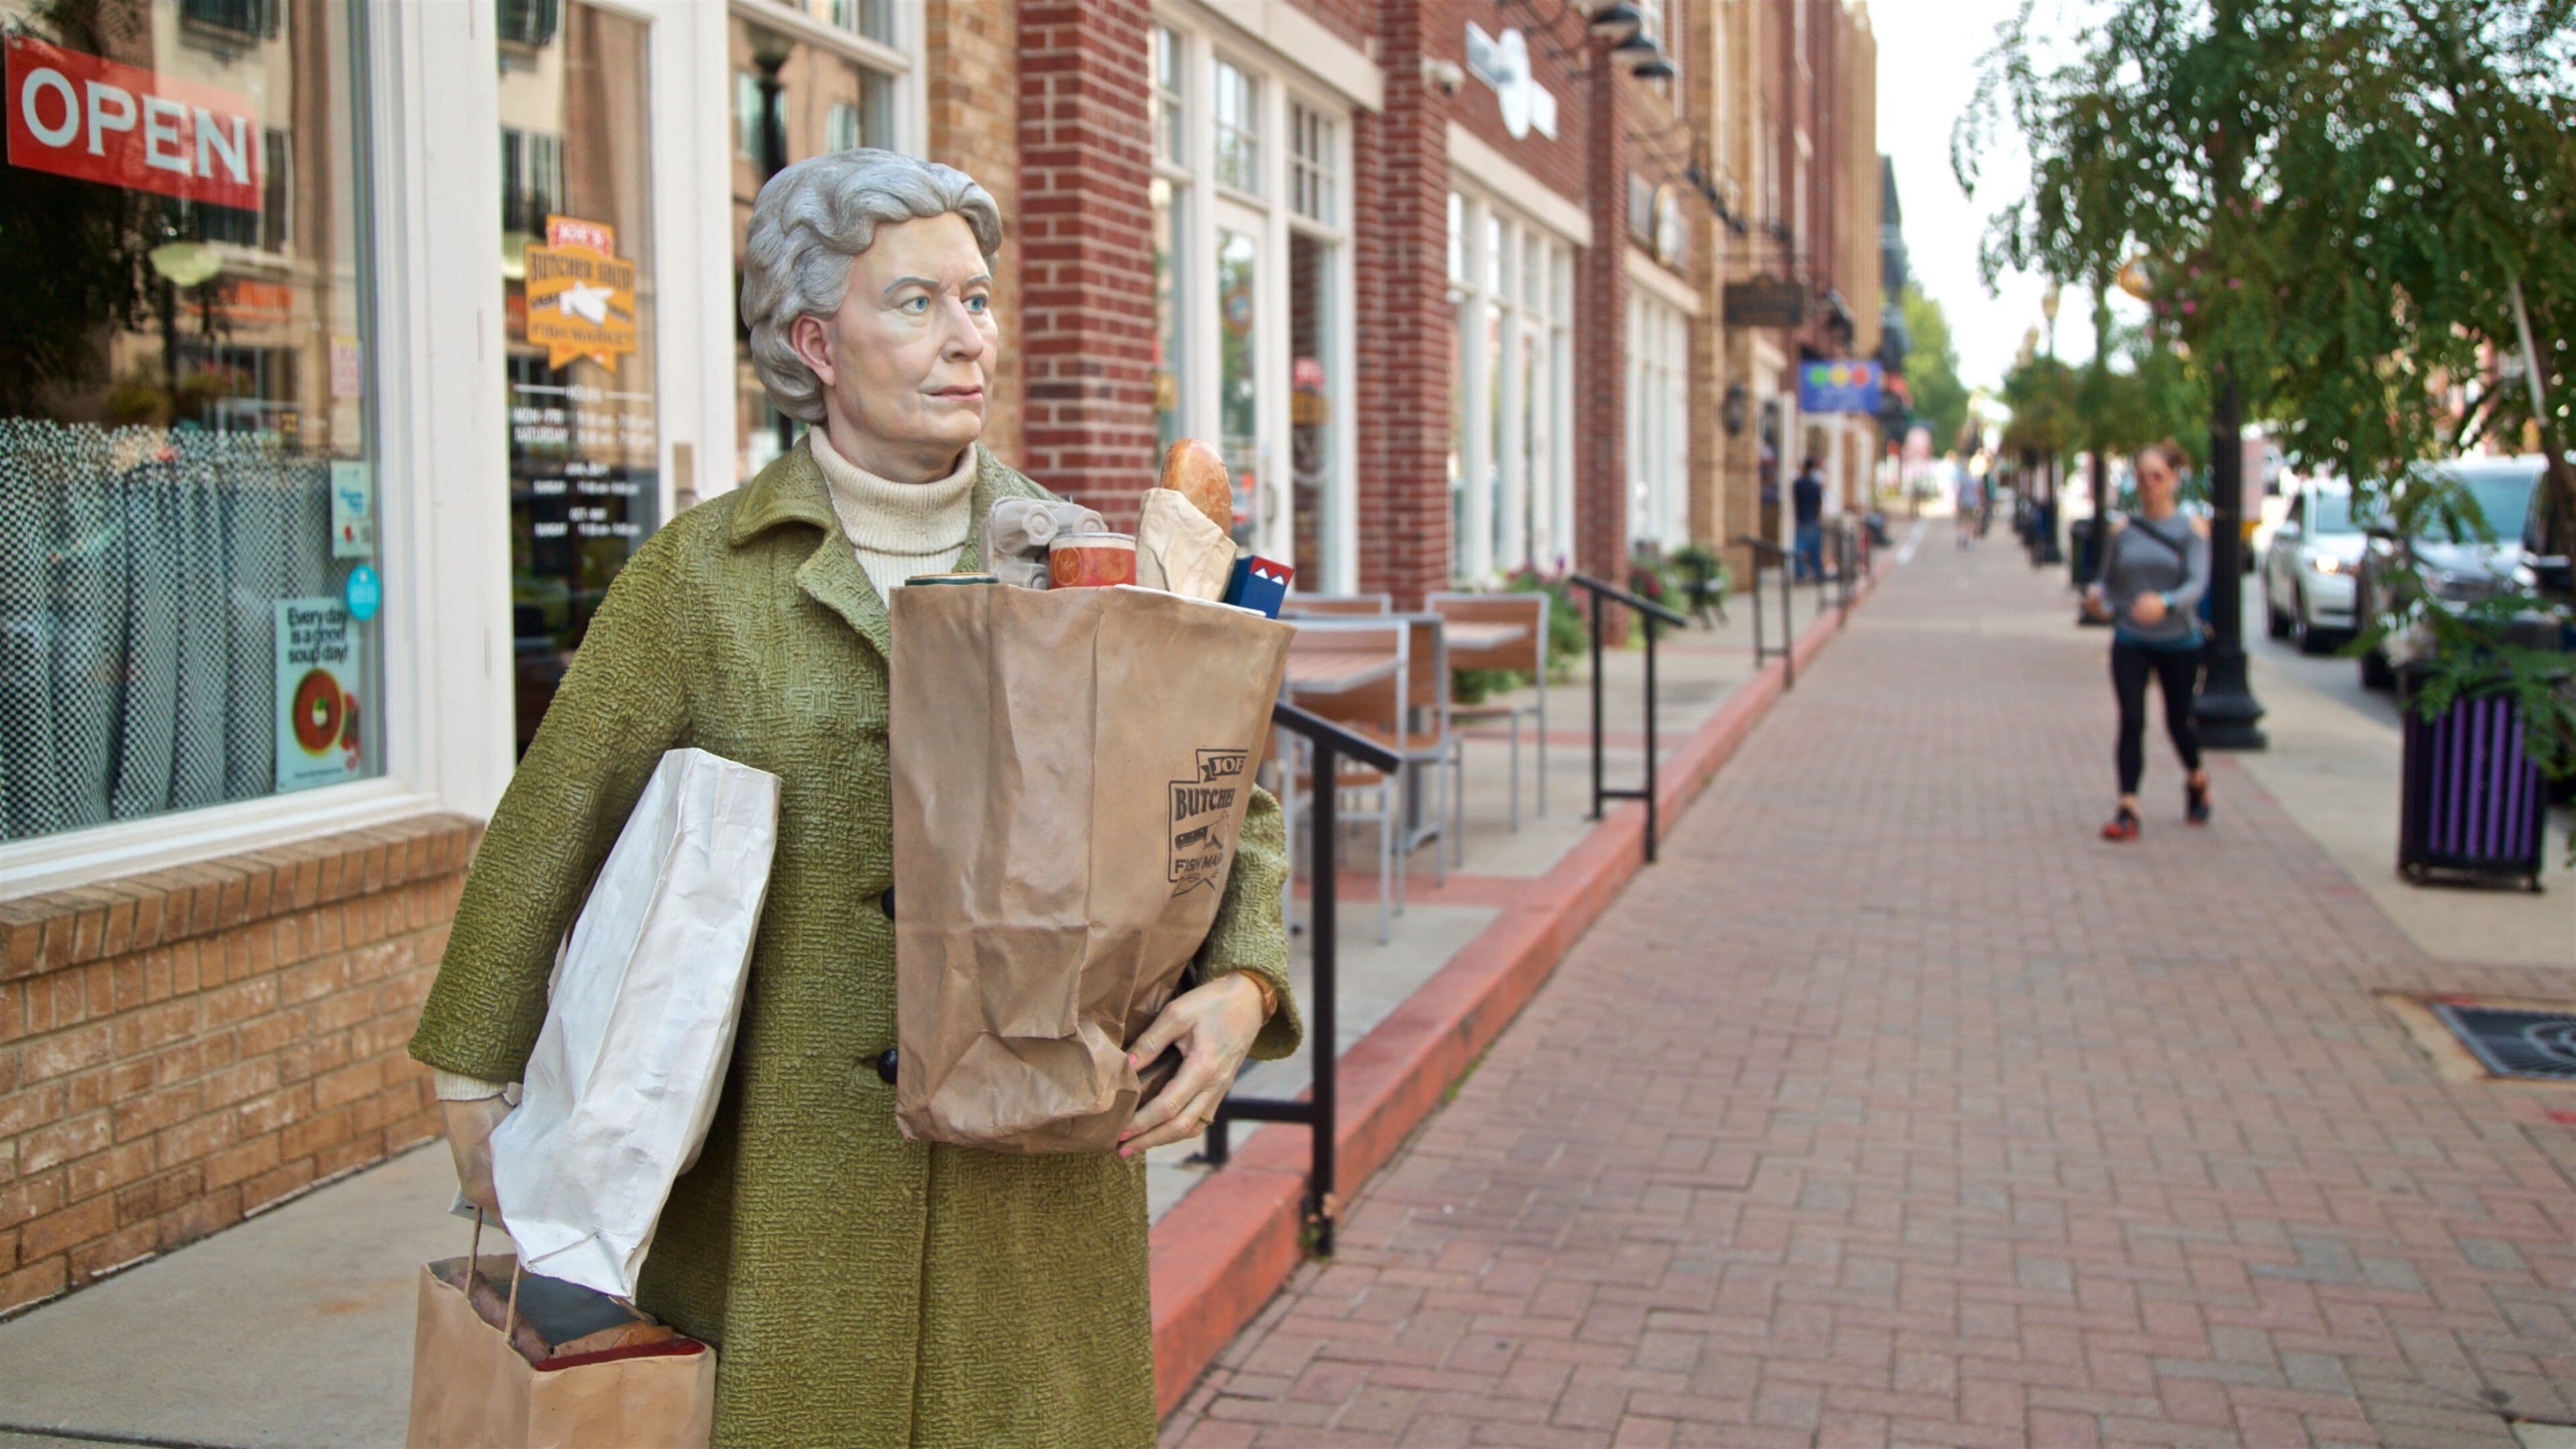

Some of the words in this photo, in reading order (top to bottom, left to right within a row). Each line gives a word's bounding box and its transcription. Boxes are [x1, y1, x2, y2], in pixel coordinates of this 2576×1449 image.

[21, 67, 250, 185] OPEN
[531, 252, 591, 282] BUTCHER
[597, 261, 633, 290] SHOP
[531, 322, 566, 338] FISH
[571, 327, 633, 345] MARKET
[514, 425, 568, 443] SATURDAY
[288, 606, 322, 628] Every
[325, 606, 347, 627] day
[291, 629, 301, 644] is
[304, 630, 311, 643] a
[314, 626, 345, 646] good
[288, 648, 320, 667] soup
[322, 645, 348, 665] day!
[1175, 857, 1202, 874] FISH
